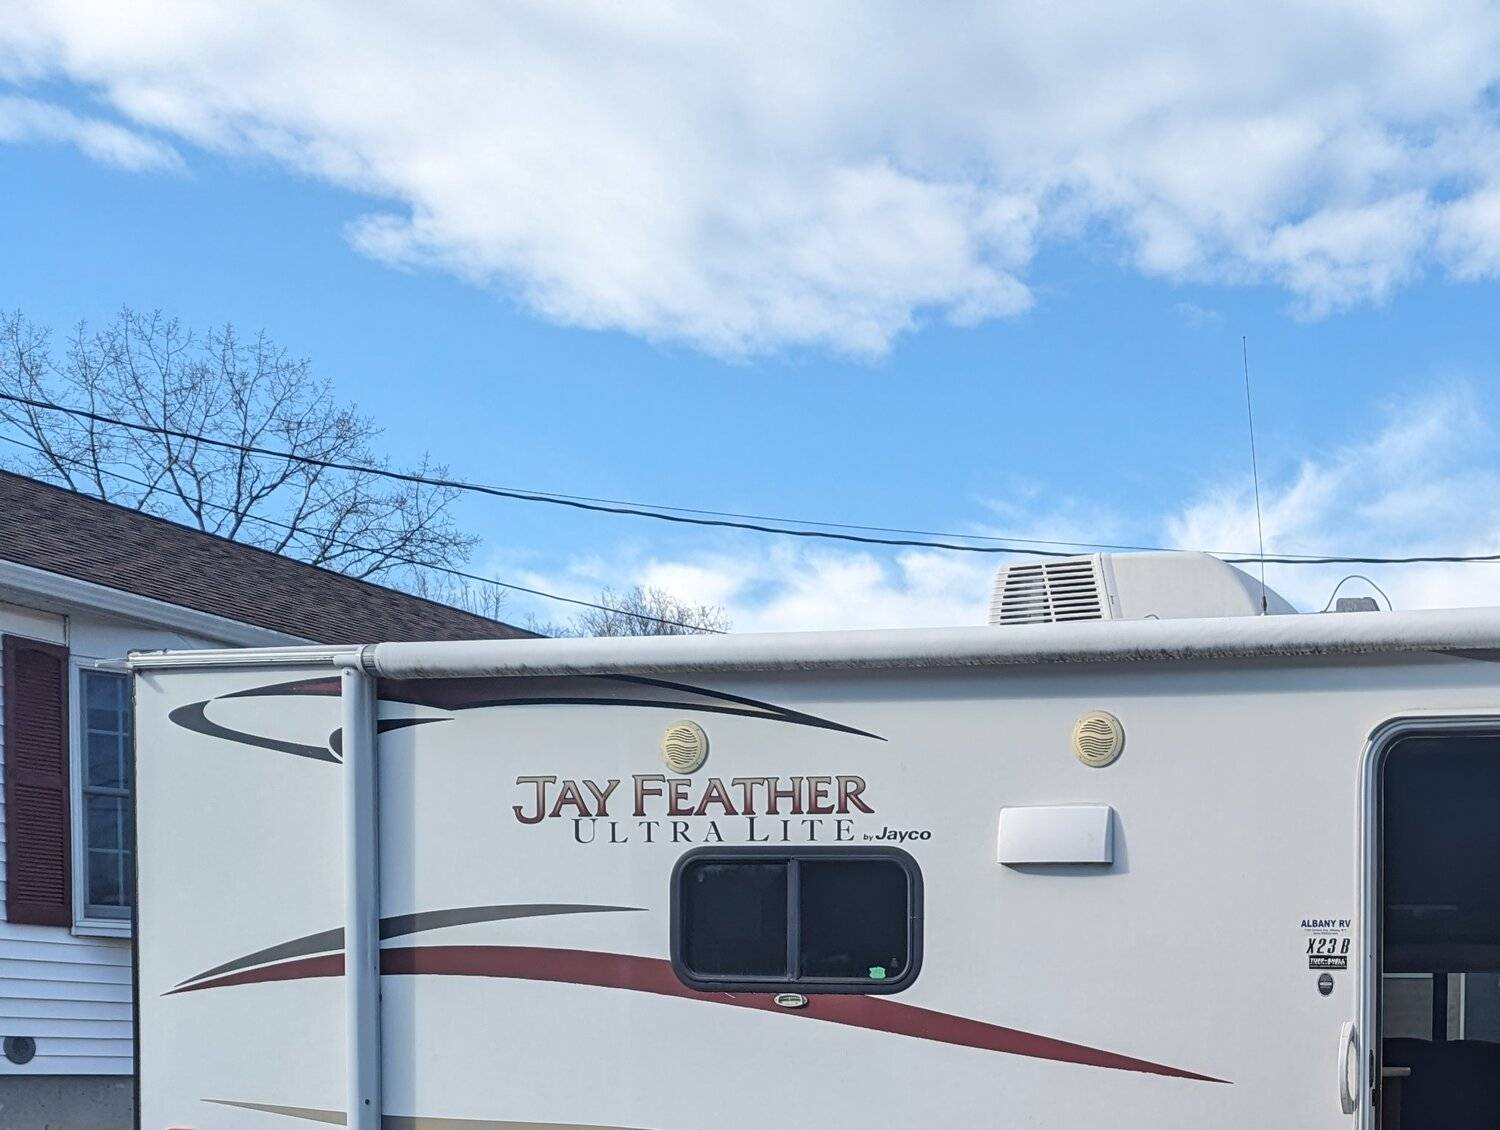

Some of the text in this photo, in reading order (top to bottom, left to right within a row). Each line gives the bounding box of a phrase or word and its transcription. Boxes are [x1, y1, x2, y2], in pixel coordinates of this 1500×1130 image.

[512, 774, 875, 824] JAY FEATHER
[571, 816, 855, 844] ULTRA LITE
[863, 826, 932, 843] by Jayco
[1301, 920, 1352, 928] ALBANY RV
